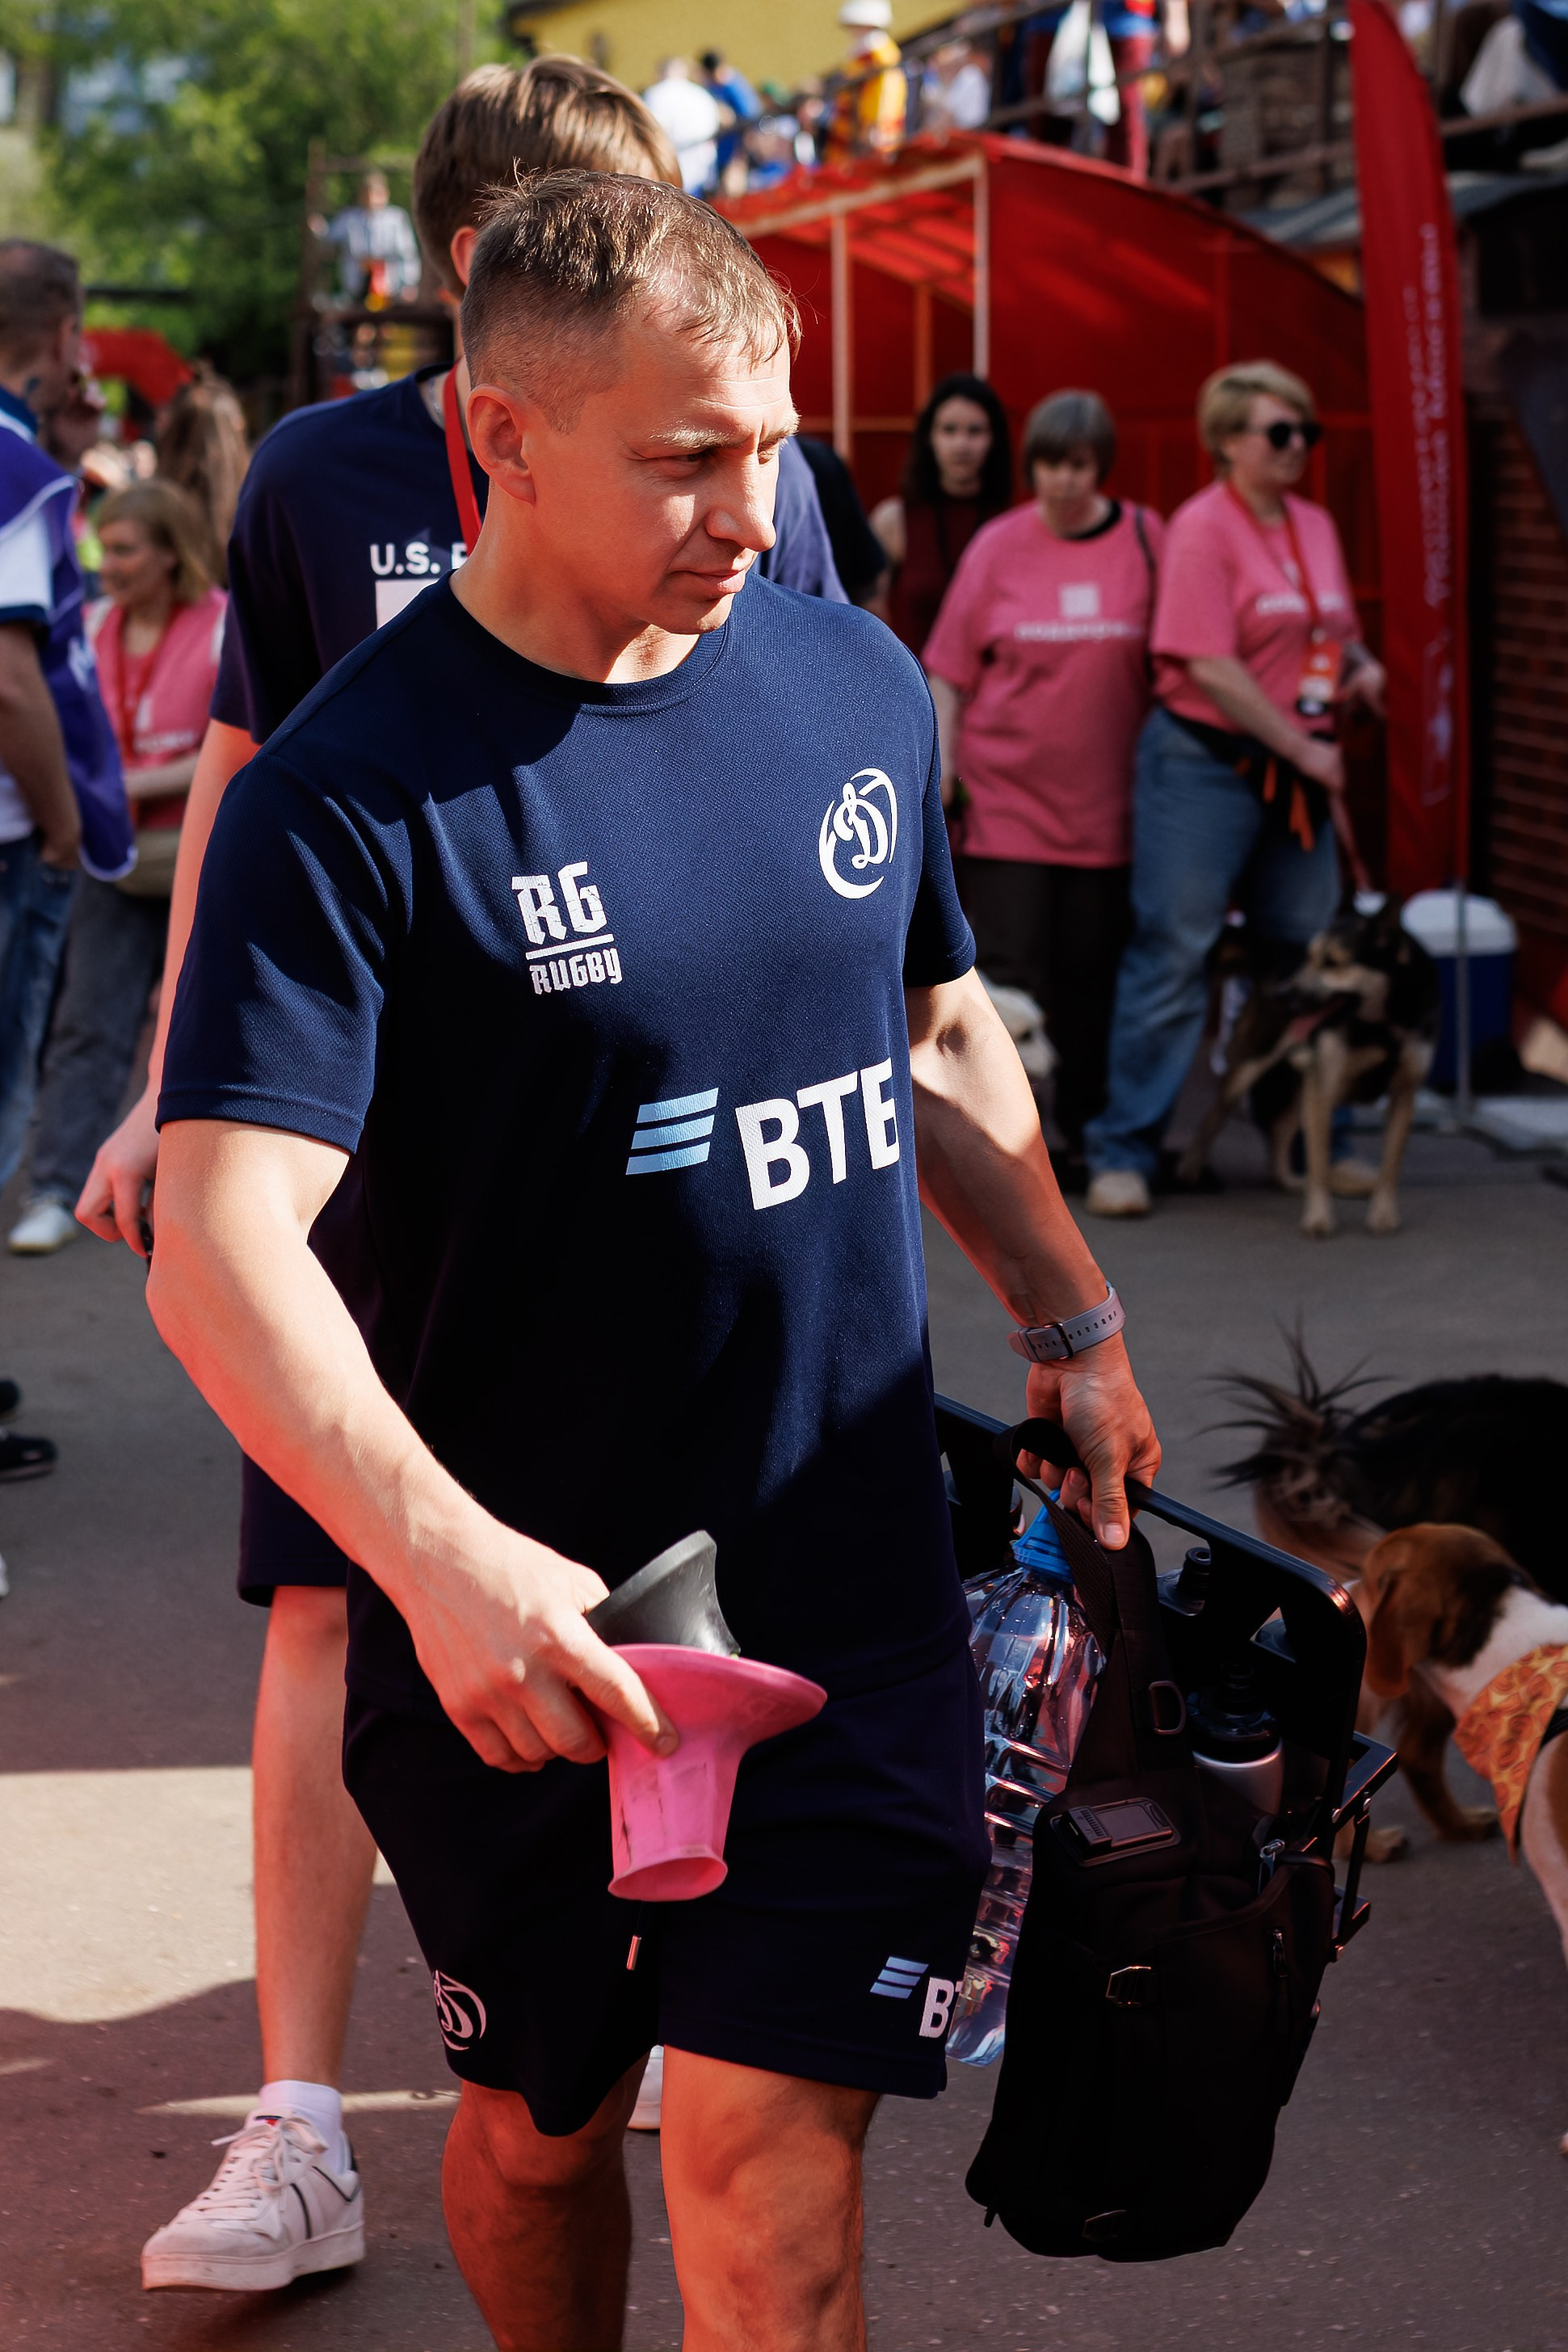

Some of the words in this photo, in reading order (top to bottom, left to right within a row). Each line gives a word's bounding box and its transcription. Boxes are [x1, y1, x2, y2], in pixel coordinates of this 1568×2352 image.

[370, 541, 441, 575] U.S.
[511, 860, 607, 945] RG
[529, 948, 623, 995] RUGBY
